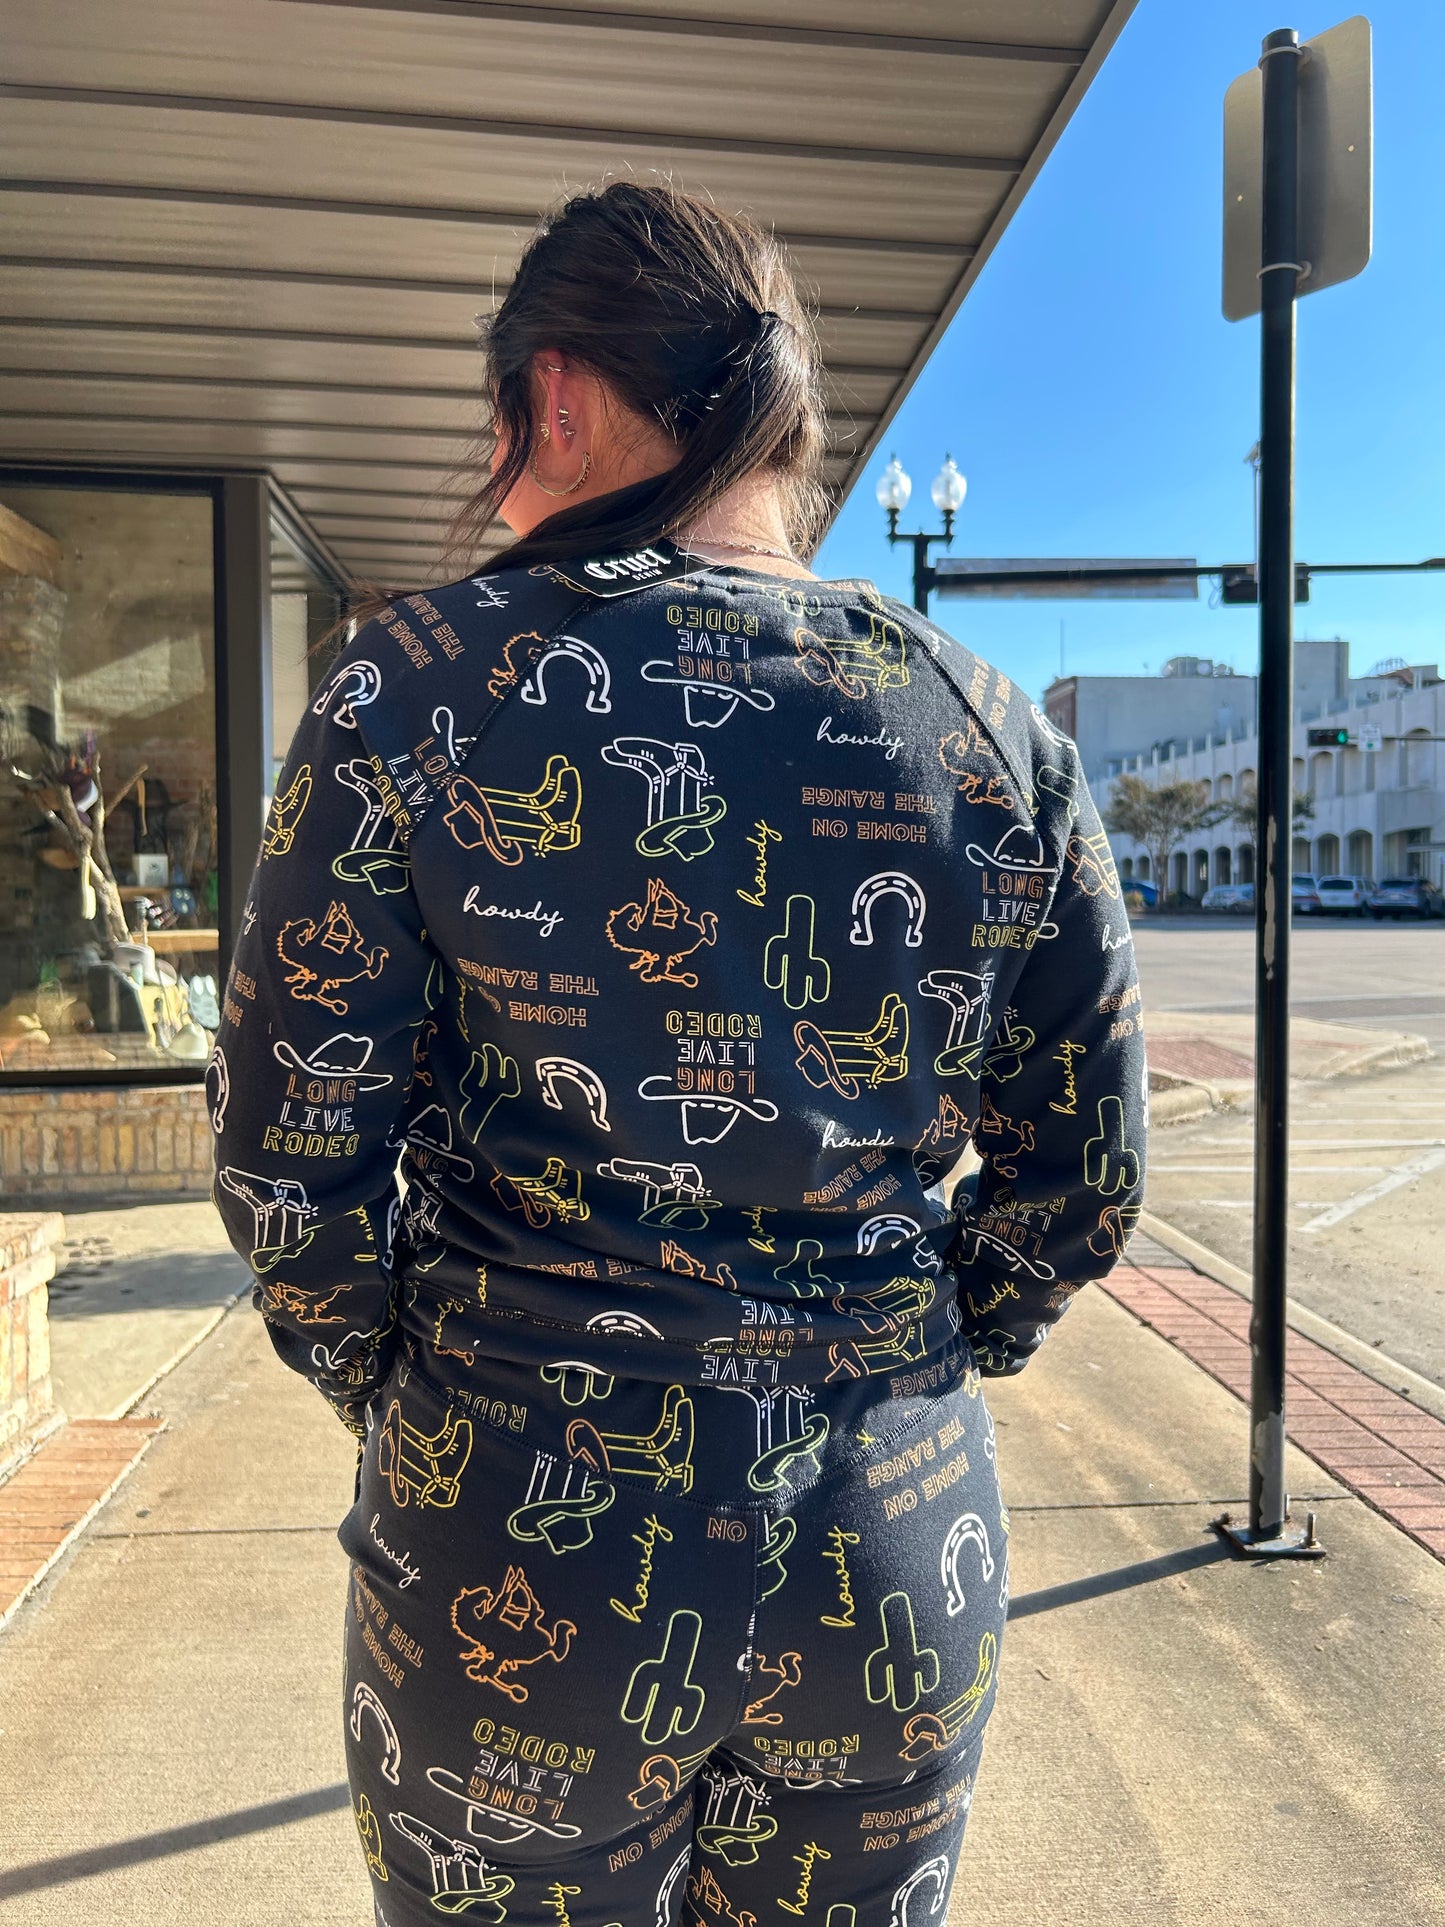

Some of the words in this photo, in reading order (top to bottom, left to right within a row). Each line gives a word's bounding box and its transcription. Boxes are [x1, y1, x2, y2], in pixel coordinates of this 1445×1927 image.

[584, 547, 671, 580] Cruel
[631, 568, 663, 581] DENIM
[666, 605, 759, 637] RODEO
[387, 622, 433, 670] HOME
[432, 622, 465, 661] THE
[677, 629, 749, 660] LIVE
[678, 655, 751, 685] LONG
[816, 716, 904, 760] howdy
[801, 786, 886, 811] RANGE
[895, 791, 936, 814] THE
[812, 818, 848, 839] ON
[857, 821, 927, 844] HOME
[737, 819, 783, 907] howdy
[982, 871, 1044, 899] LONG
[463, 885, 564, 938] howdy
[982, 898, 1040, 926] LIVE
[971, 924, 1039, 951] RODEO
[457, 957, 538, 991] RANGE
[550, 973, 599, 996] THE
[509, 1001, 587, 1027] HOME
[666, 1010, 762, 1038] RODEO
[1110, 1018, 1134, 1041] ON
[677, 1038, 755, 1066] LIVE
[286, 1073, 356, 1104] LONG
[677, 1067, 755, 1094] LONG
[1049, 1040, 1087, 1115] howdy
[279, 1101, 355, 1132] LIVE
[262, 1126, 360, 1158] RODEO
[860, 1147, 887, 1173] THE
[803, 1163, 863, 1204] RANGE
[856, 1173, 902, 1211] HOME
[979, 1216, 1043, 1256] LONG
[967, 1280, 1020, 1317] howdy
[701, 1354, 779, 1384] LIVE
[890, 1361, 948, 1399] RANGE
[938, 1415, 965, 1451] THE
[866, 1437, 936, 1488] RANGE
[922, 1452, 970, 1502] HOME
[883, 1489, 918, 1521] ON
[370, 1513, 421, 1589] howdy
[609, 1513, 673, 1623] howdy
[820, 1525, 861, 1628] howdy
[362, 1623, 405, 1689] HOME
[388, 1624, 424, 1668] THE
[472, 1718, 596, 1774] RODEO
[754, 1733, 860, 1758] RODEO
[474, 1748, 574, 1797] LIVE
[765, 1753, 848, 1771] LIVE
[467, 1775, 564, 1820] LONG
[860, 1797, 940, 1829] RANGE
[650, 1793, 695, 1849] HOME
[608, 1842, 643, 1873] ON
[863, 1833, 900, 1851] ON
[777, 1842, 832, 1916] howdy
